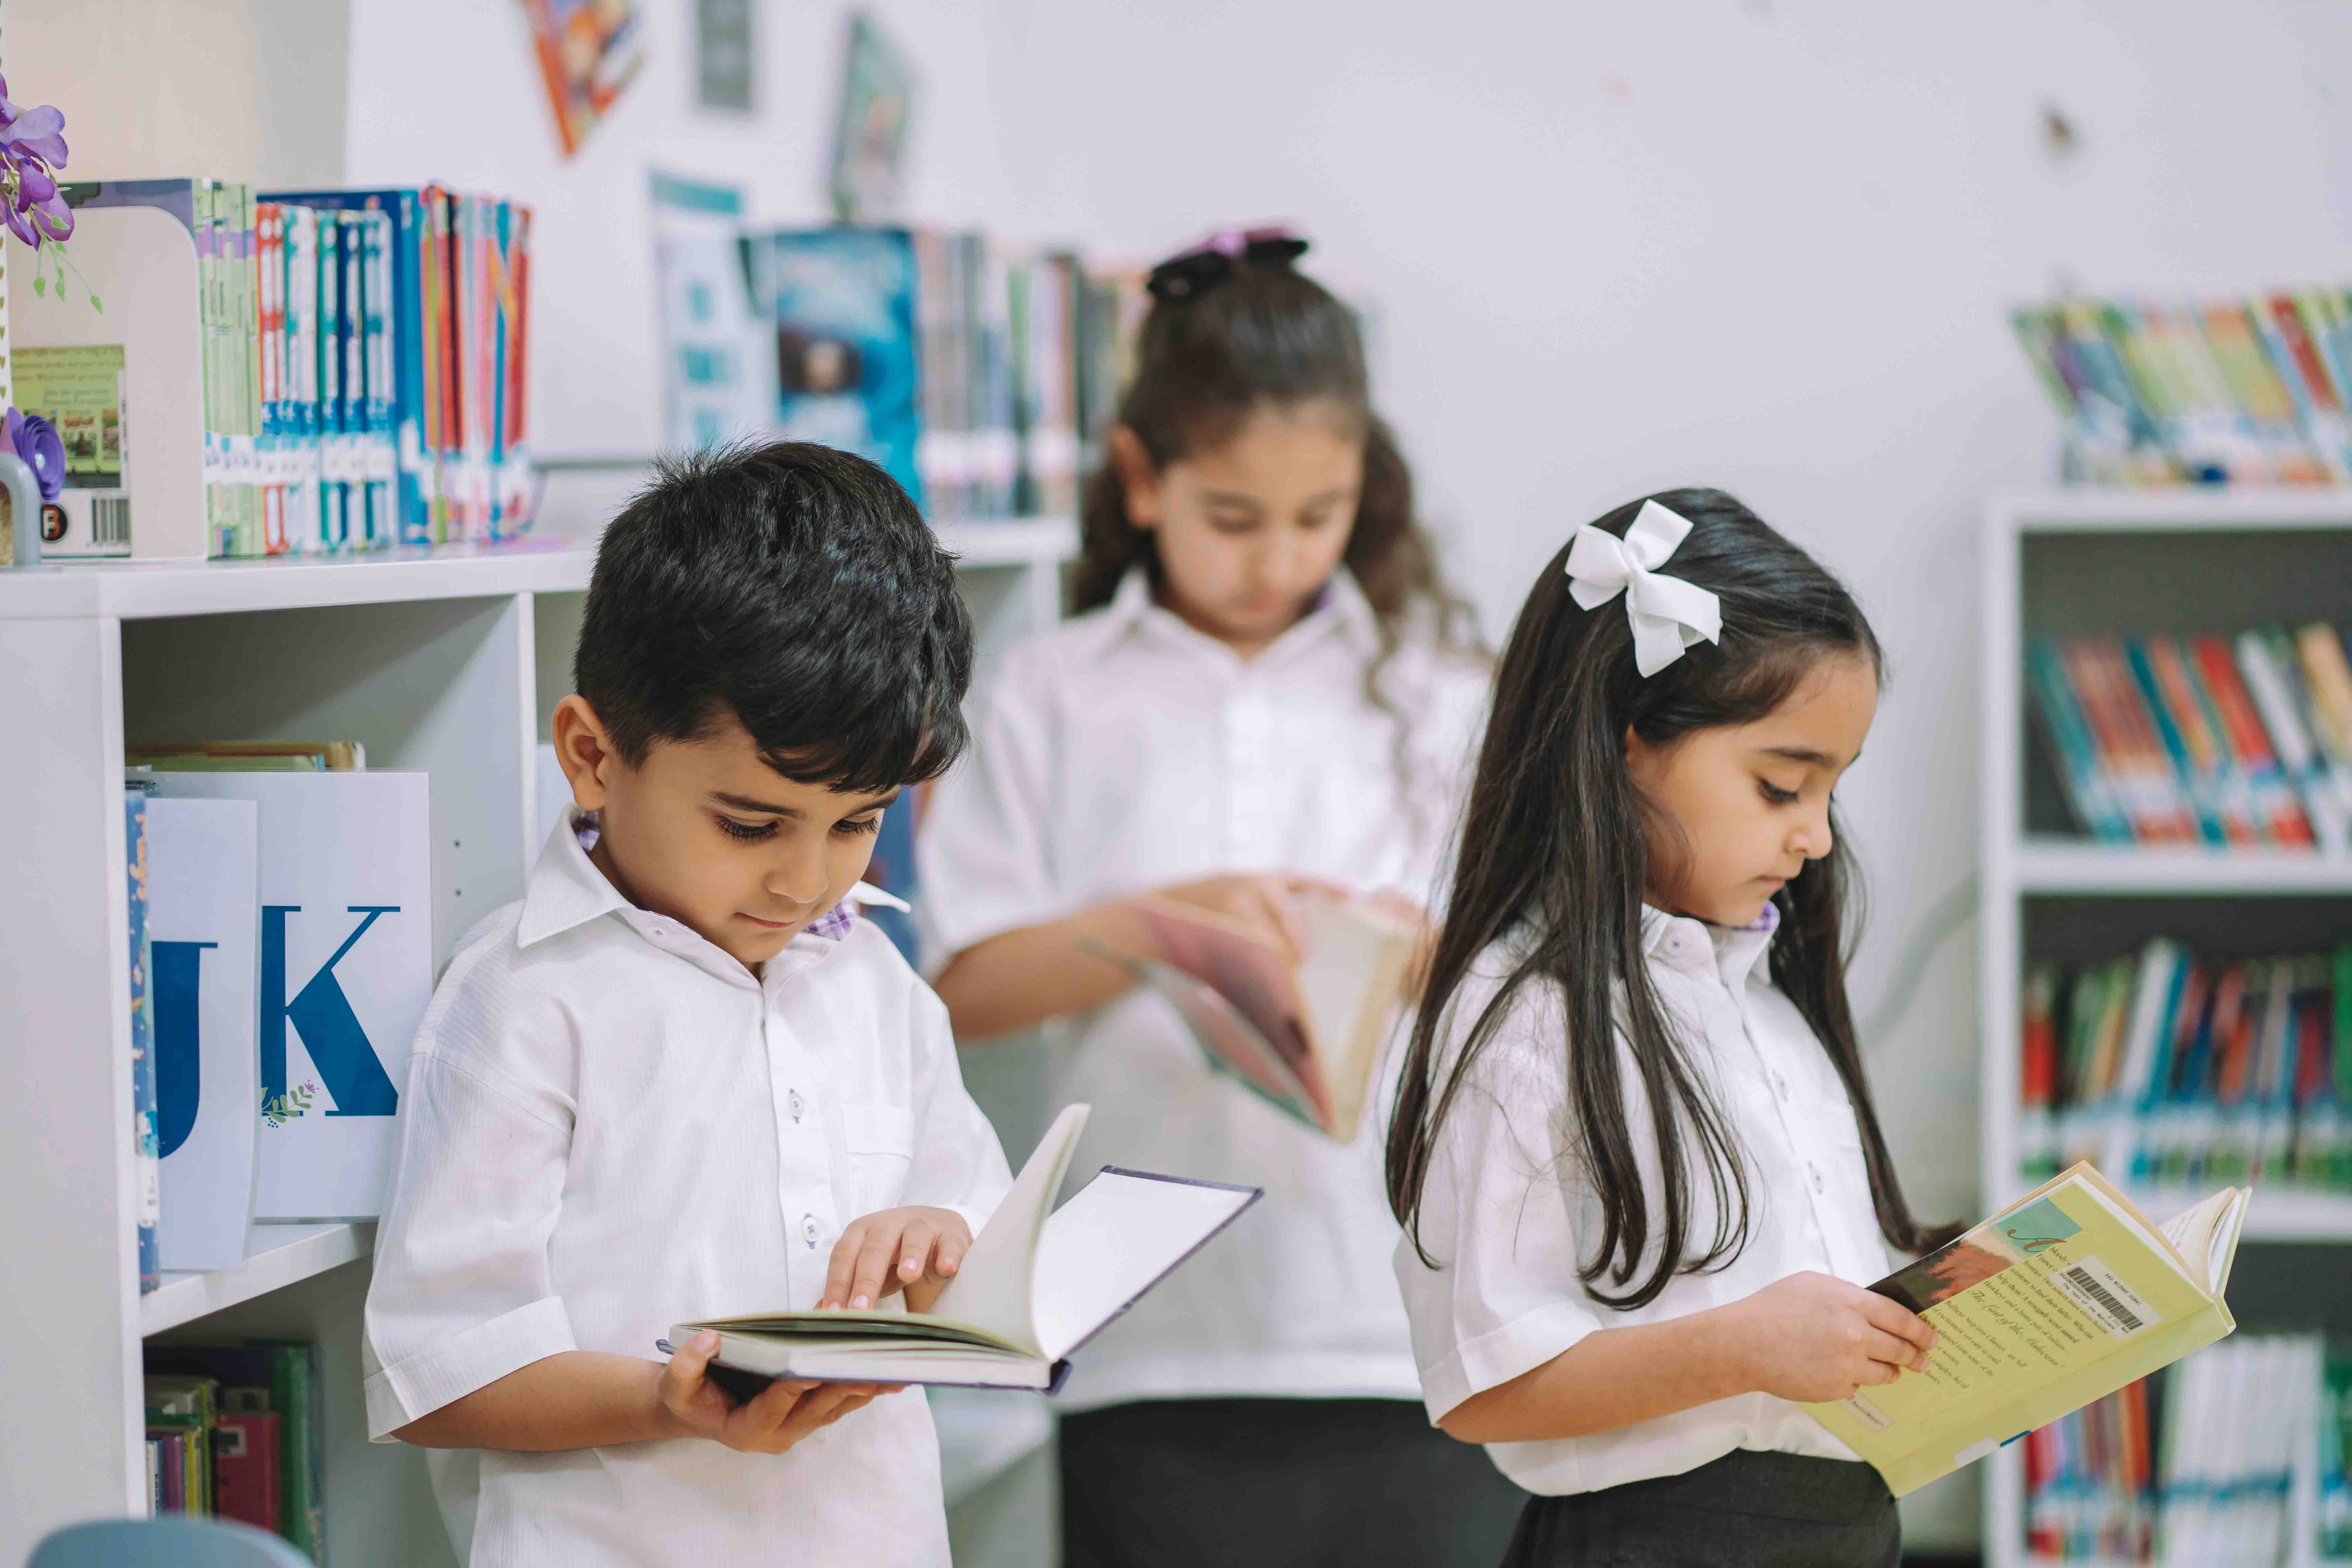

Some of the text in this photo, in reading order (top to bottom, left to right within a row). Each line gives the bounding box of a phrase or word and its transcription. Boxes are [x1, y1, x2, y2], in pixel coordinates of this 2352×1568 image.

[260, 906, 401, 1117] K
[2036, 1253, 2054, 1268] France
[2049, 1246, 2068, 1262] bloody
[1966, 1289, 1986, 1305] The
[1981, 1304, 2004, 1320] Last
[1983, 1281, 2007, 1300] Hawkeye
[2004, 1299, 2018, 1309] and
[2017, 1309, 2032, 1323] brave
[1997, 1273, 2009, 1285] help
[2025, 1300, 2051, 1319] renegade
[2060, 1329, 2080, 1344] named
[2009, 1267, 2031, 1285] territory
[2034, 1288, 2049, 1299] find
[2045, 1298, 2059, 1309] their
[2073, 1319, 2085, 1332] Who
[1936, 1330, 1959, 1346] adapted
[1955, 1344, 1969, 1355] from
[1967, 1354, 1981, 1366] some
[1937, 1312, 1964, 1334] excitement
[1970, 1340, 1982, 1349] easy
